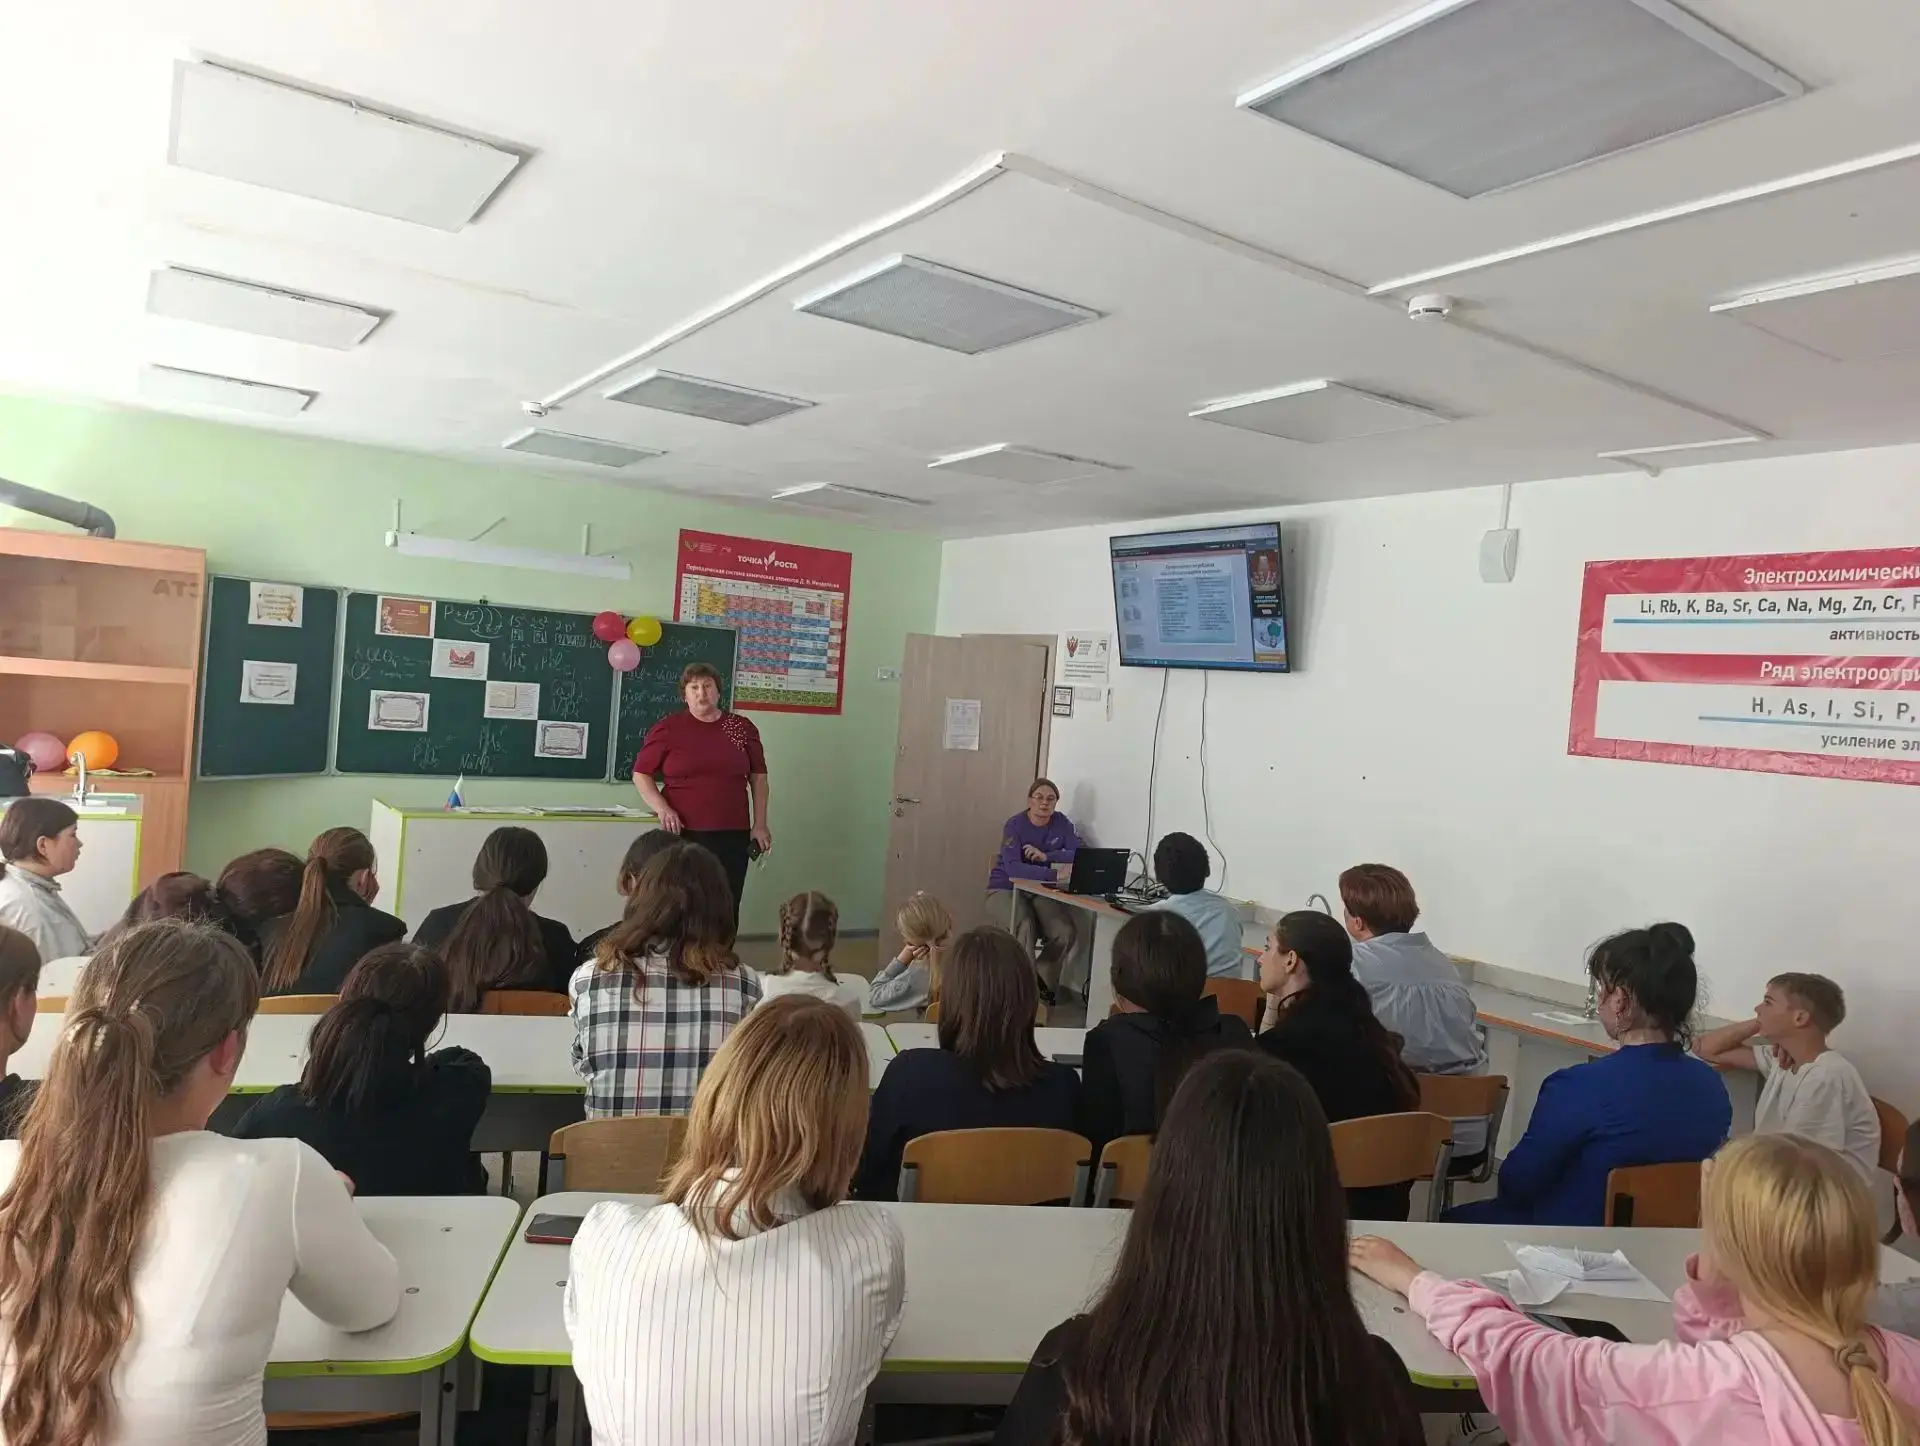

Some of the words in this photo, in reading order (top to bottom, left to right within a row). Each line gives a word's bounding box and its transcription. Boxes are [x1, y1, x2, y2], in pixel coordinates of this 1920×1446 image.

[738, 555, 763, 565] ТОЧКА
[774, 561, 798, 570] РОСТА
[1640, 599, 1656, 615] Li,
[1660, 599, 1681, 615] Rb,
[1686, 599, 1700, 615] K,
[1705, 599, 1728, 615] Ba,
[1732, 598, 1752, 615] Sr,
[1757, 598, 1781, 615] Ca,
[1786, 597, 1813, 614] Na,
[1818, 597, 1847, 615] Mg,
[1852, 596, 1877, 613] Zn,
[1883, 595, 1905, 612] Cr,
[1829, 629, 1920, 641] активность
[1760, 661, 1795, 681] Ряд
[1783, 698, 1816, 718] As,
[1853, 700, 1883, 721] Si,
[1896, 702, 1916, 723] P,
[1821, 734, 1897, 749] усиление
